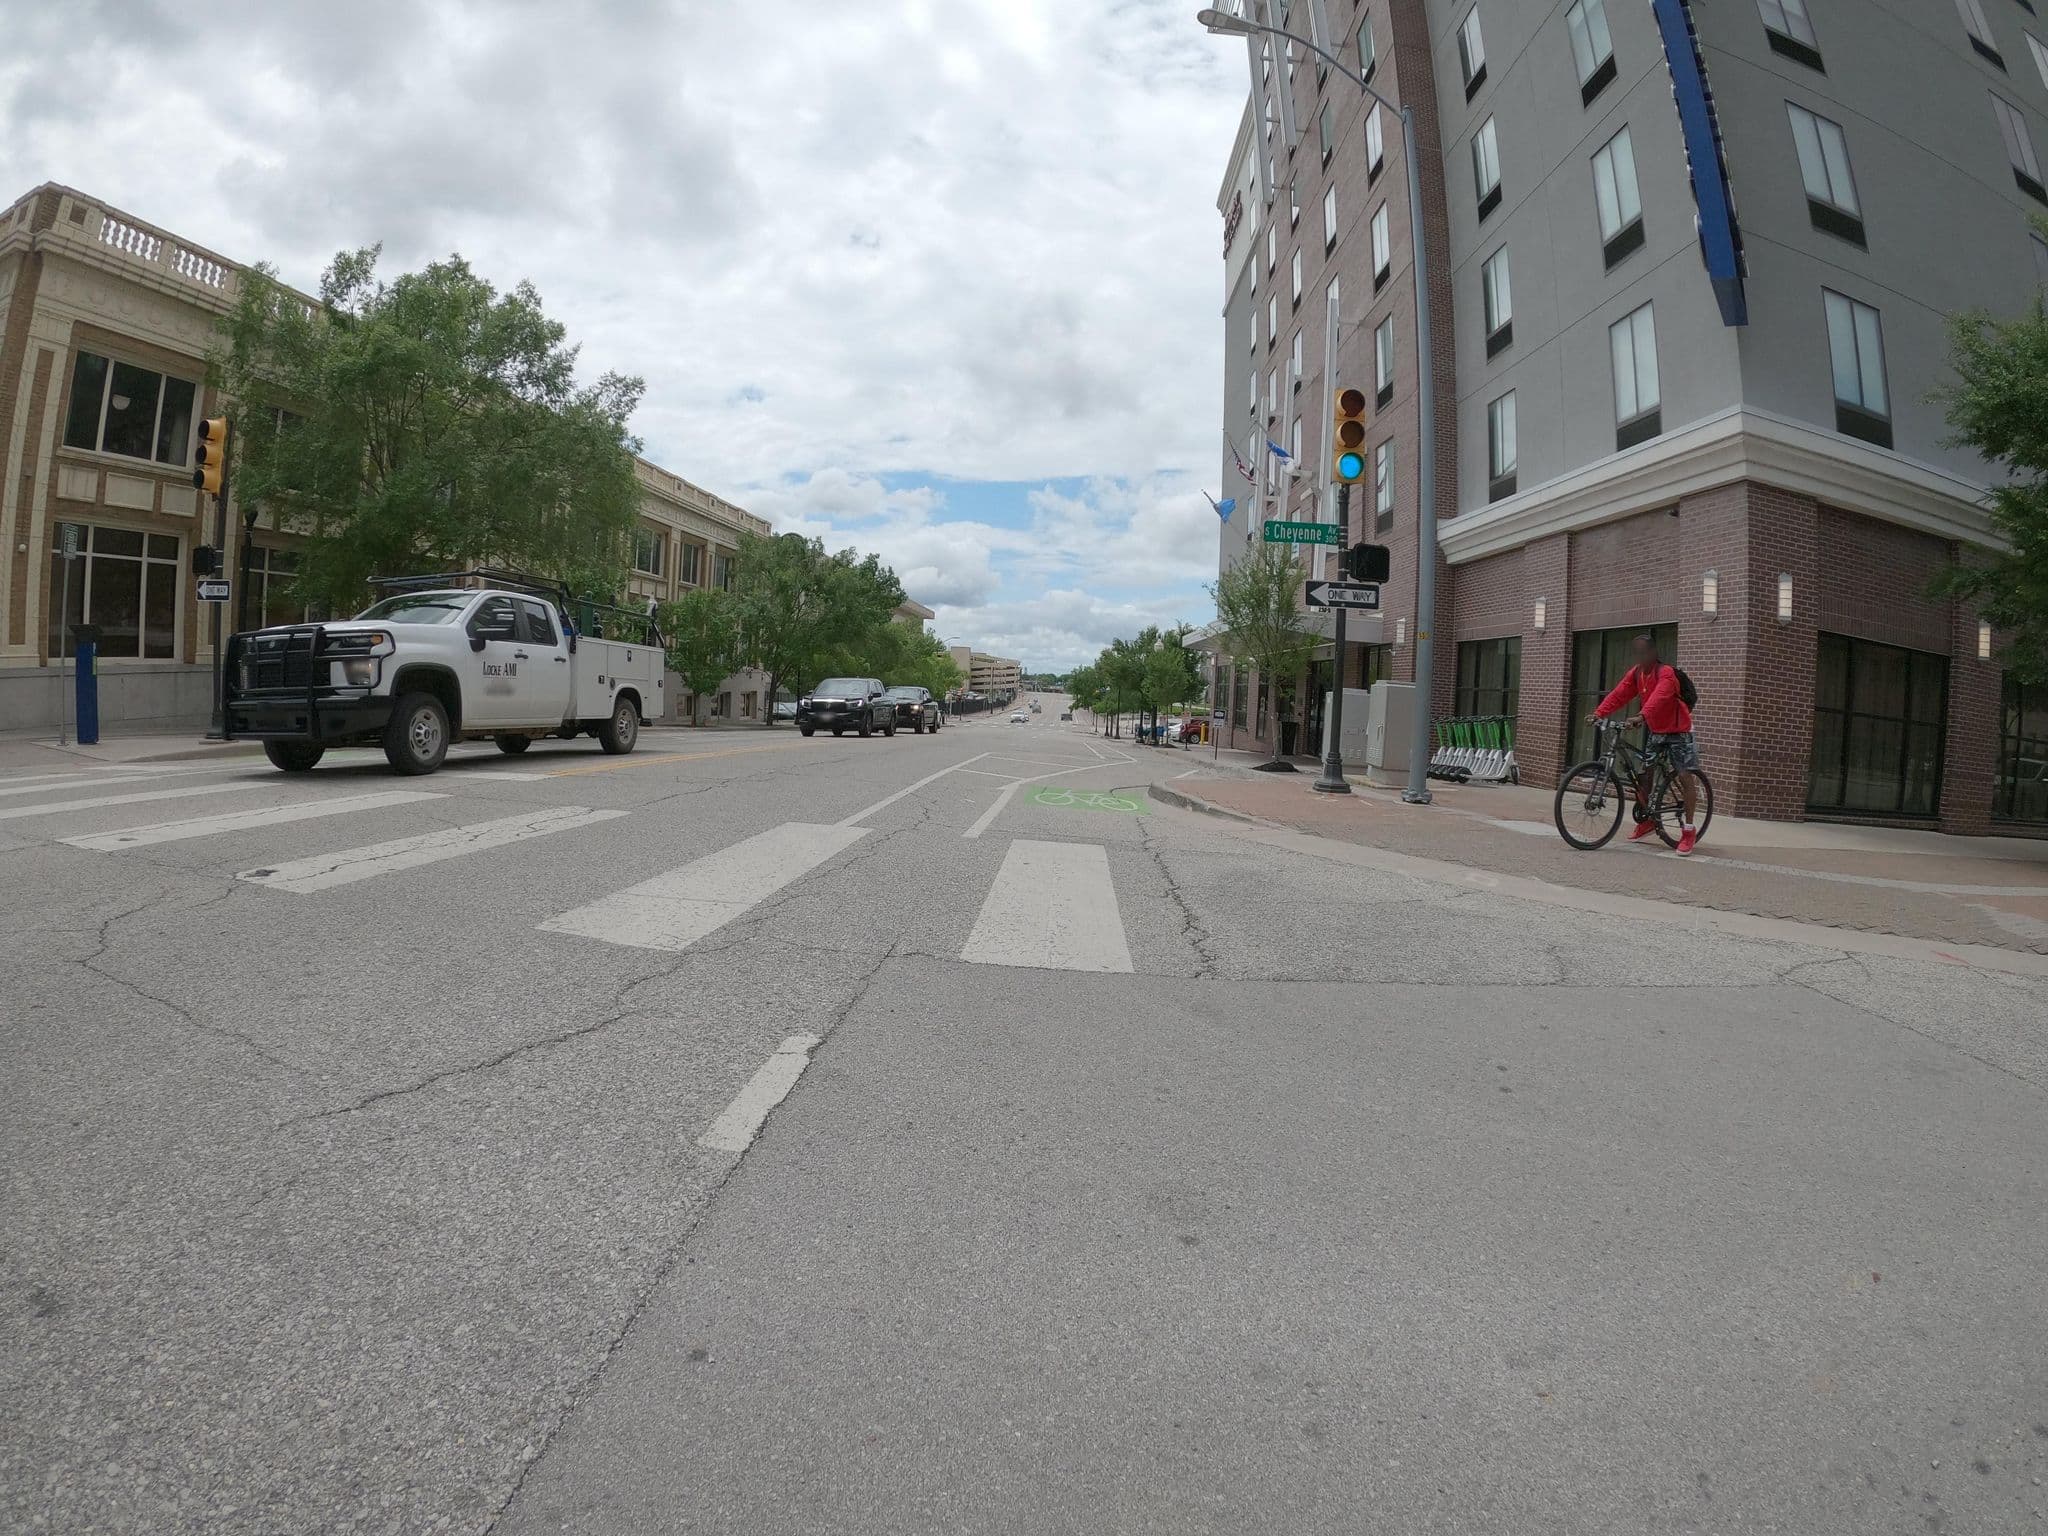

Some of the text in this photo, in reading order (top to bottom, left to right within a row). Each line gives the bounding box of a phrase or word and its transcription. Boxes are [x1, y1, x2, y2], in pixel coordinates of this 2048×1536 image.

[1264, 524, 1322, 543] S Cheyenne
[1328, 589, 1372, 602] ONE WAY
